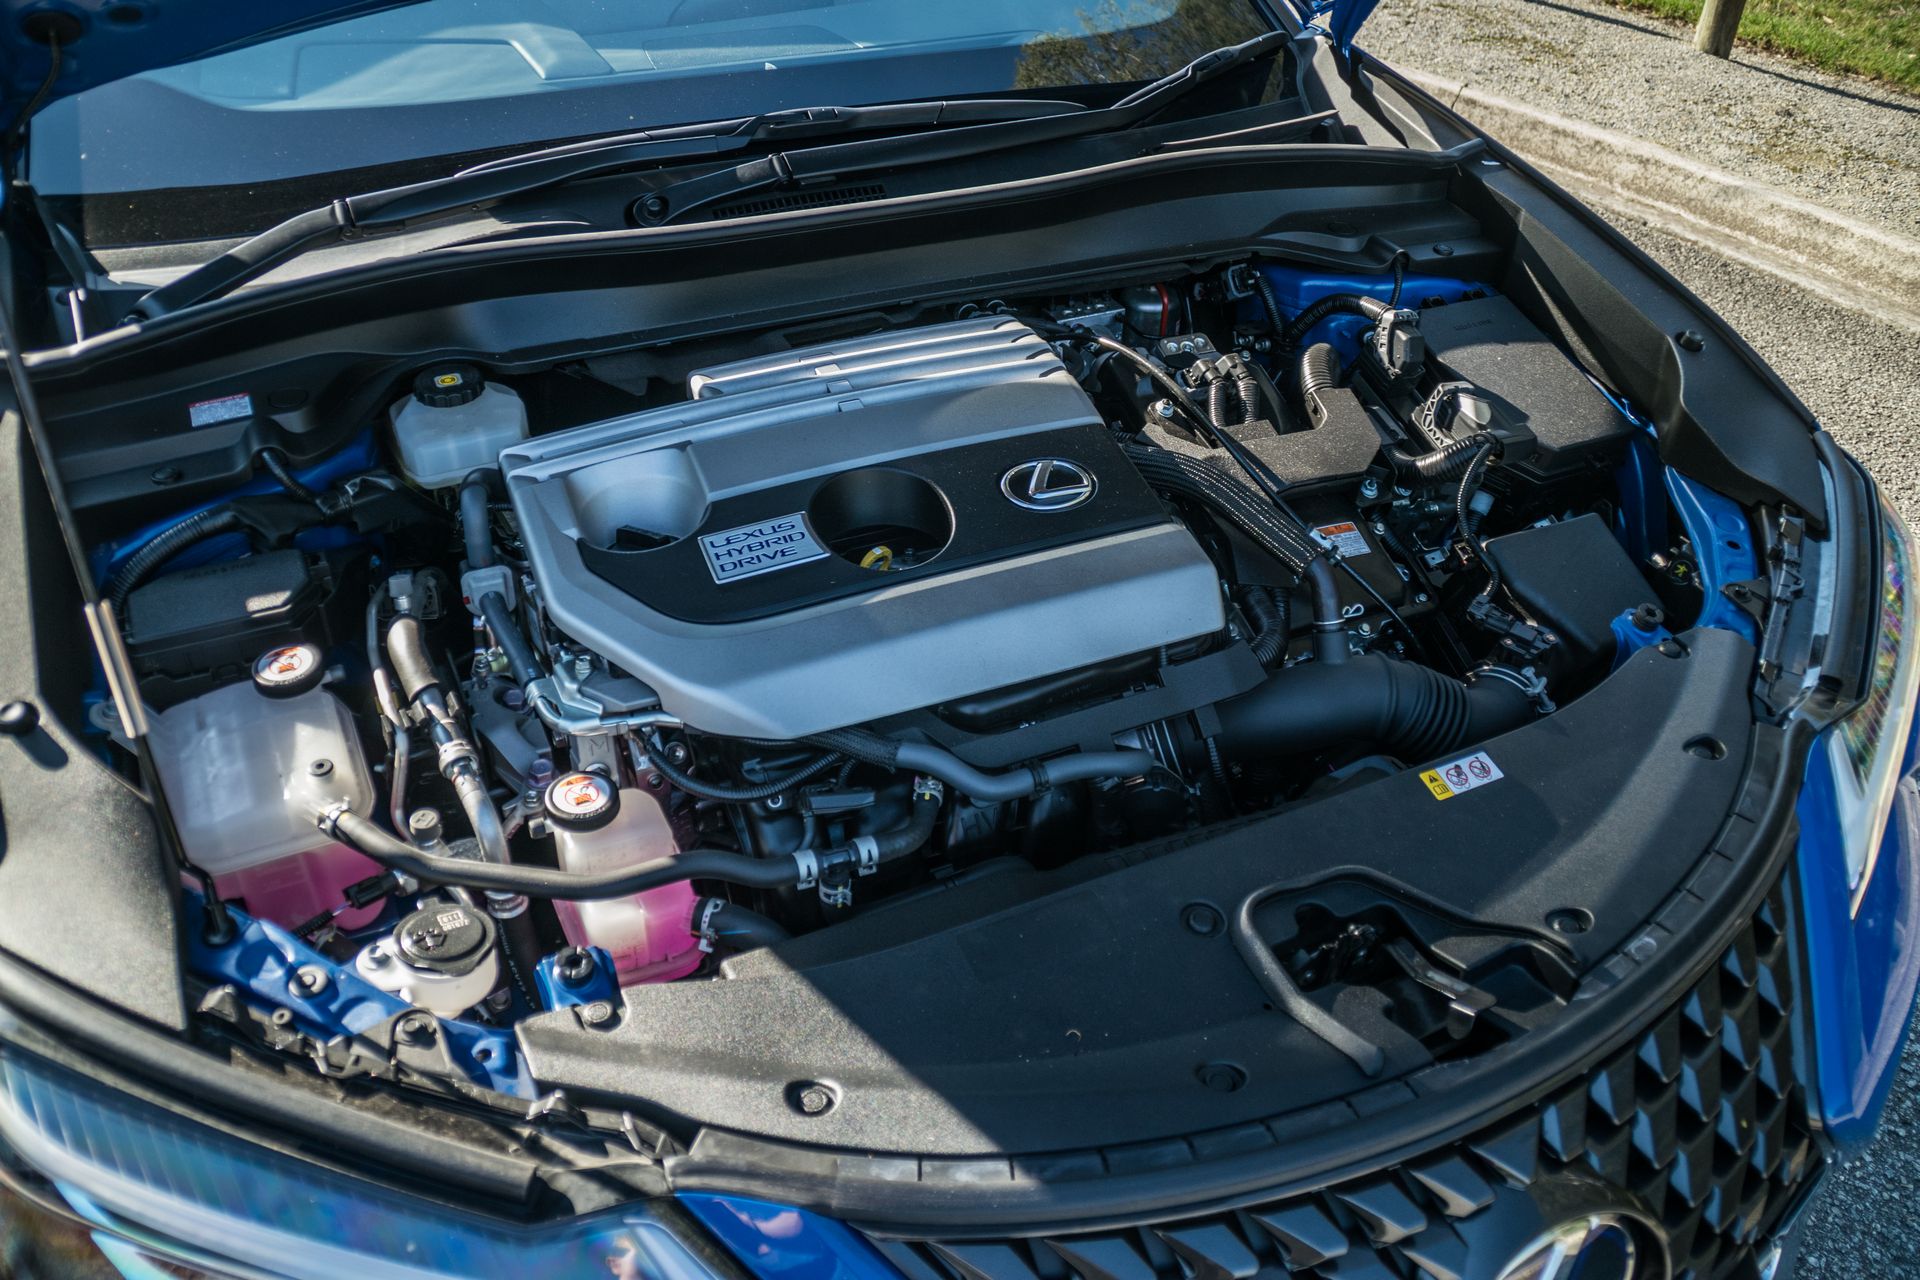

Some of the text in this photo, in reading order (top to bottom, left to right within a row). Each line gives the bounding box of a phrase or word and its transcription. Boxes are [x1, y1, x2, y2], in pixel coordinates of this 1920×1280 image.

[709, 520, 795, 548] LEXUS
[713, 531, 805, 561] HYBRID
[719, 545, 798, 573] DRIVE
